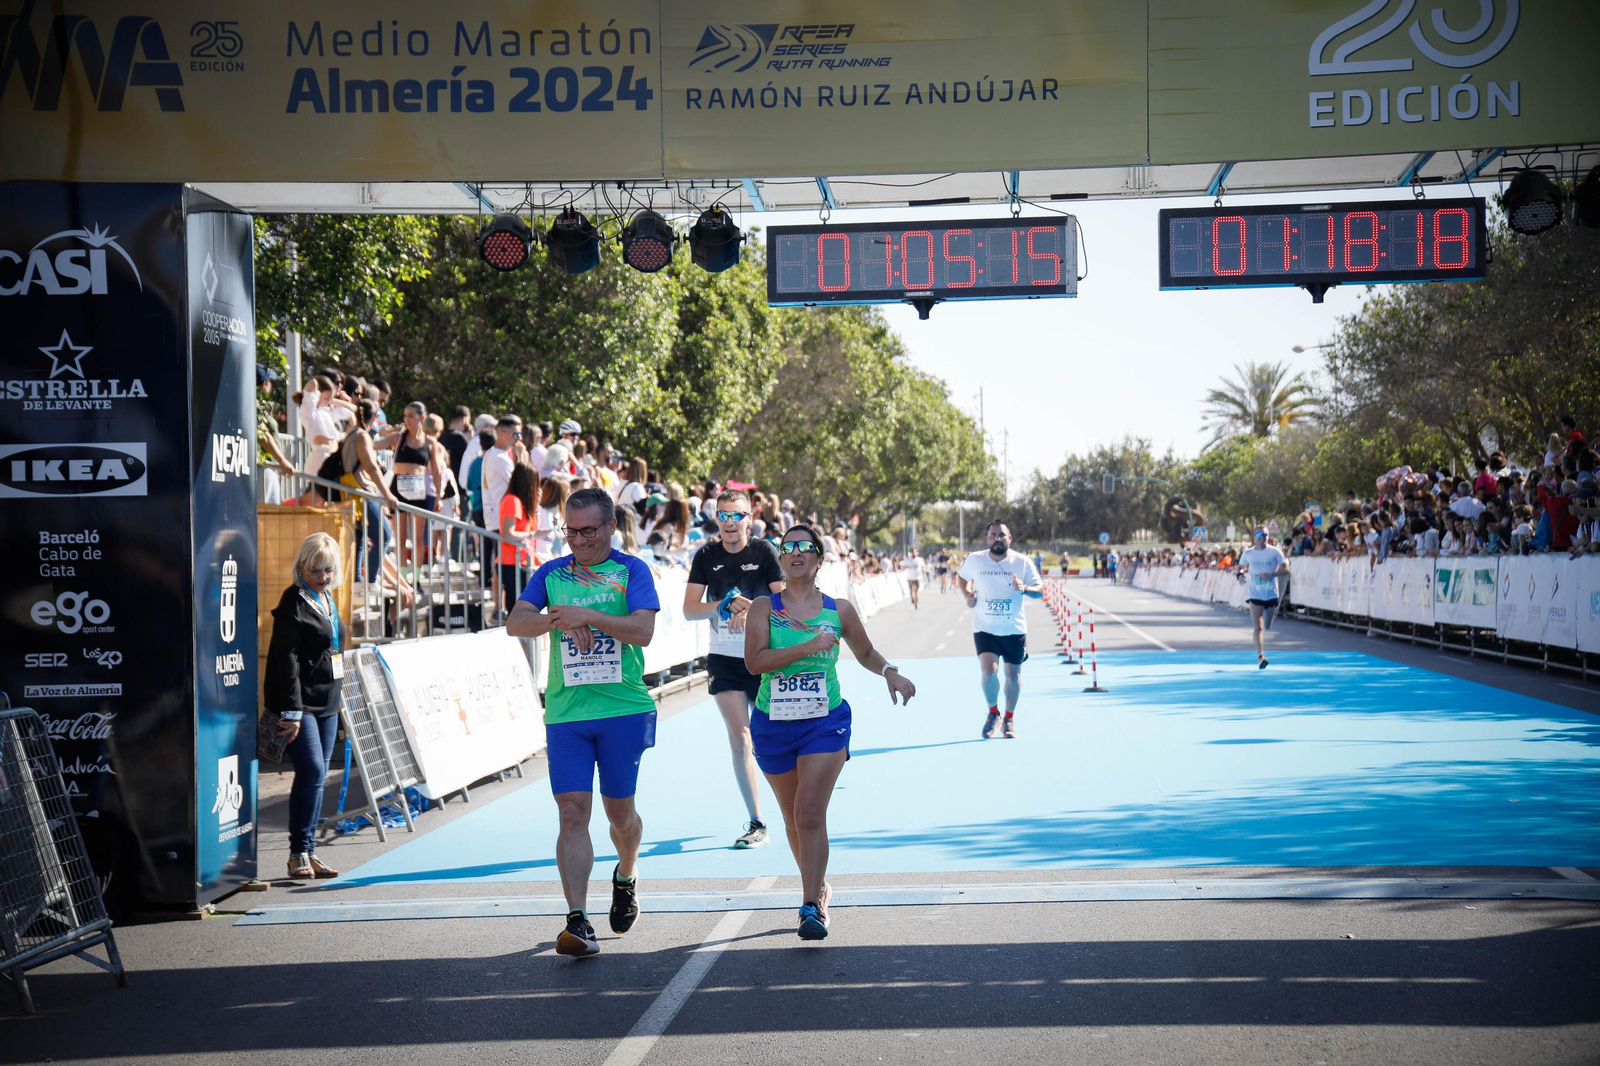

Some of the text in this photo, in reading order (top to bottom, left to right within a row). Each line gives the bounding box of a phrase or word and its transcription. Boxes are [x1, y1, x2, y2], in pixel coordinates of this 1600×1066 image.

[190, 20, 244, 58] 25
[286, 18, 652, 57] Medio Maratón
[779, 23, 856, 43] RFEA
[772, 43, 848, 58] SERIES
[190, 59, 244, 72] EDICIÓN
[766, 56, 893, 72] RUTA RUNNING
[285, 65, 654, 114] Almería 2024
[686, 75, 1059, 110] RAMÓN RUIZ ANDÚJAR
[1308, 73, 1521, 128] EDICIÓN
[1212, 208, 1470, 276] 01:18:18
[817, 226, 1061, 292] 01:05:15
[0, 248, 109, 297] CASI
[202, 310, 247, 336] COOPERACIÓN
[202, 327, 220, 346] 2005
[0, 378, 148, 400] STRELLA
[23, 400, 112, 411] DE LEVANTE
[11, 459, 130, 482] IKEA
[39, 529, 100, 544] Barceló
[39, 546, 102, 561] Cabo de
[39, 563, 76, 577] Gata
[571, 592, 616, 606] SAKATA
[987, 602, 1010, 611] 5293
[30, 591, 111, 634] ego
[82, 625, 115, 634] sport center
[24, 652, 68, 668] SER
[97, 650, 123, 670] 40
[215, 649, 245, 674] ALMERÍA
[223, 673, 240, 687] CIUDAD
[778, 677, 821, 693] 5884
[26, 685, 120, 696] La Voz de Almería
